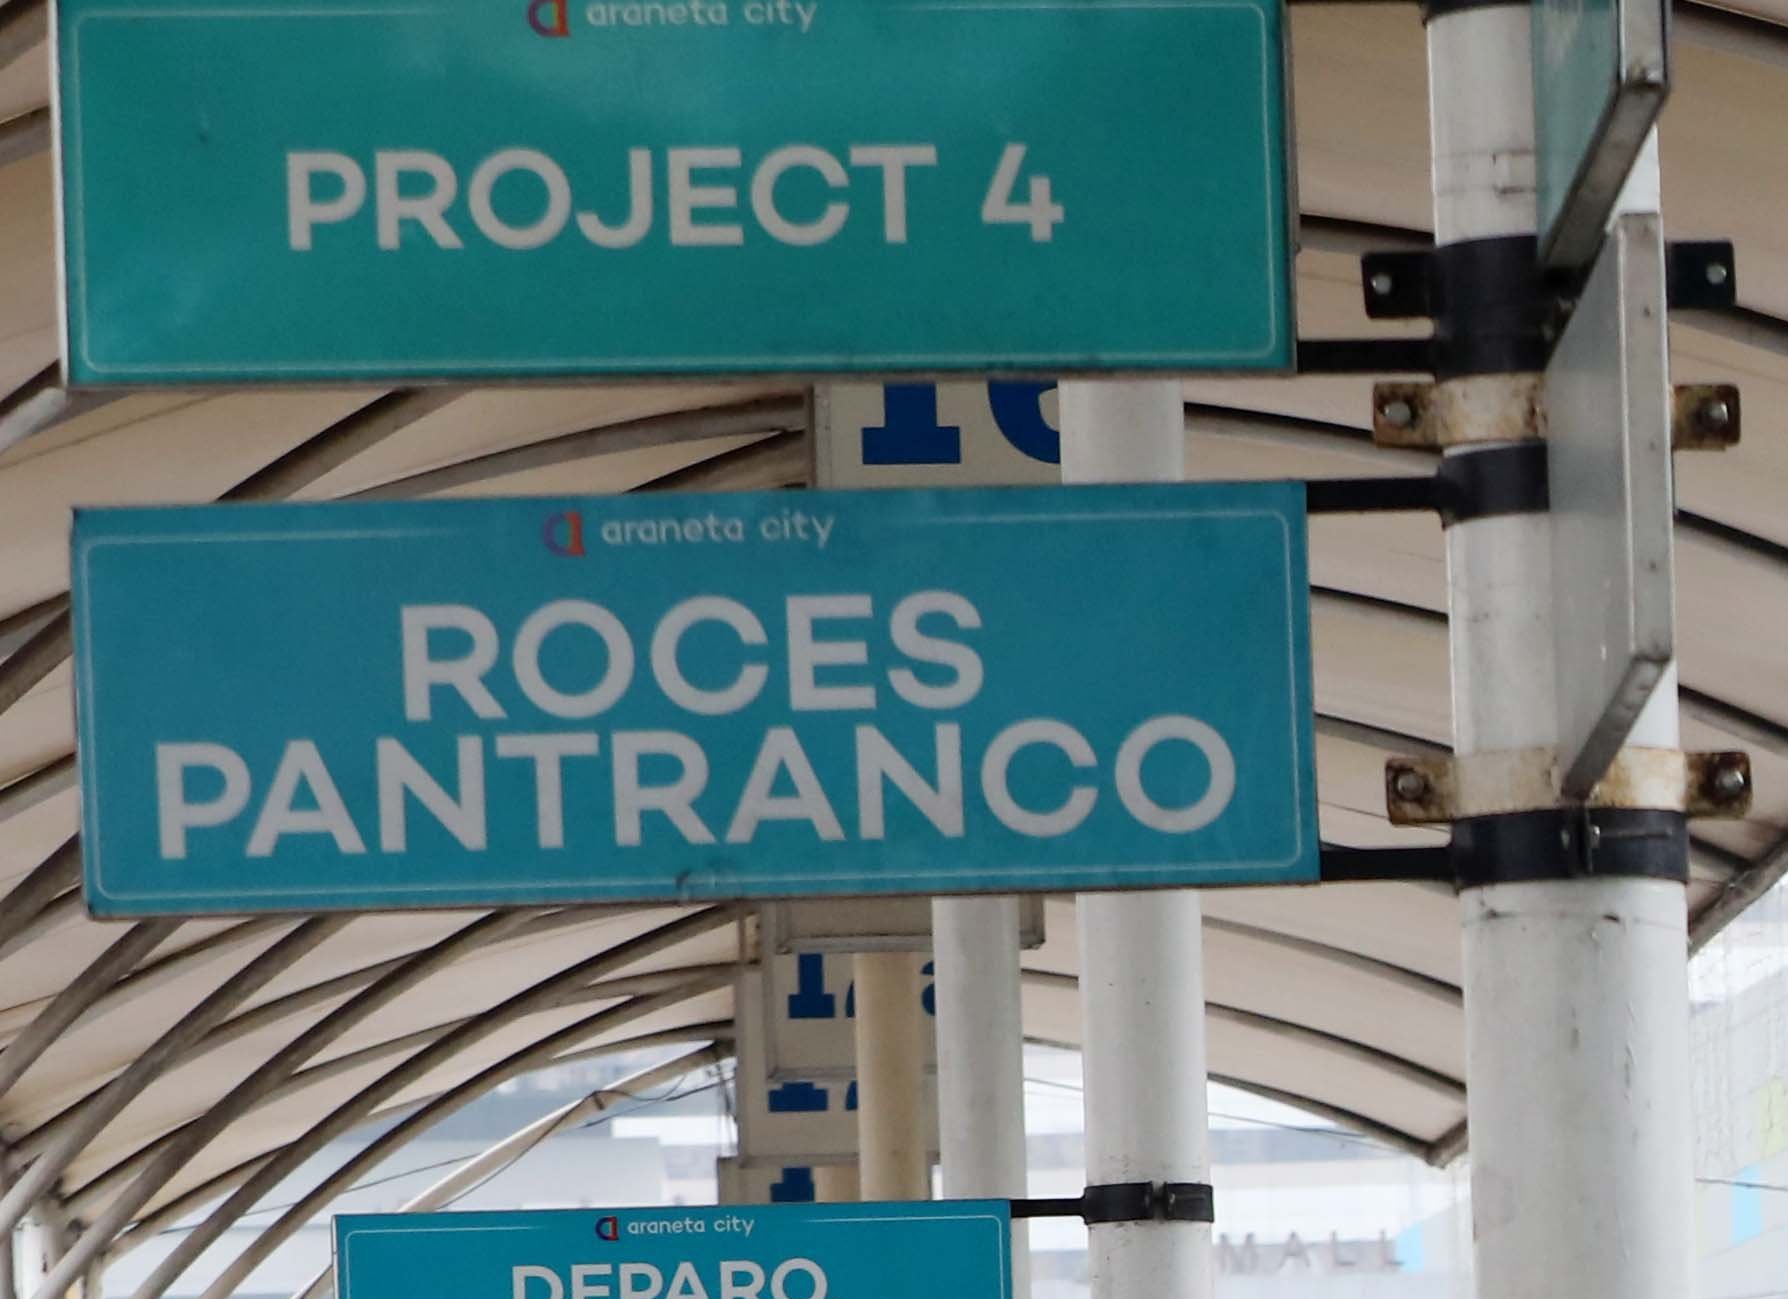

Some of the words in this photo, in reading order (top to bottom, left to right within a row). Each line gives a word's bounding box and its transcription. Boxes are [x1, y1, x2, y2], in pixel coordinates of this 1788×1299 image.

[586, 0, 728, 26] araneta
[743, 0, 817, 33] city
[286, 143, 937, 252] PROJECT
[982, 141, 1065, 244] 4
[602, 513, 745, 545] araneta
[760, 507, 835, 550] city
[402, 591, 986, 723] ROCES
[155, 716, 1238, 861] PANTRANCO
[627, 1216, 706, 1235] araneta
[713, 1214, 756, 1238] city
